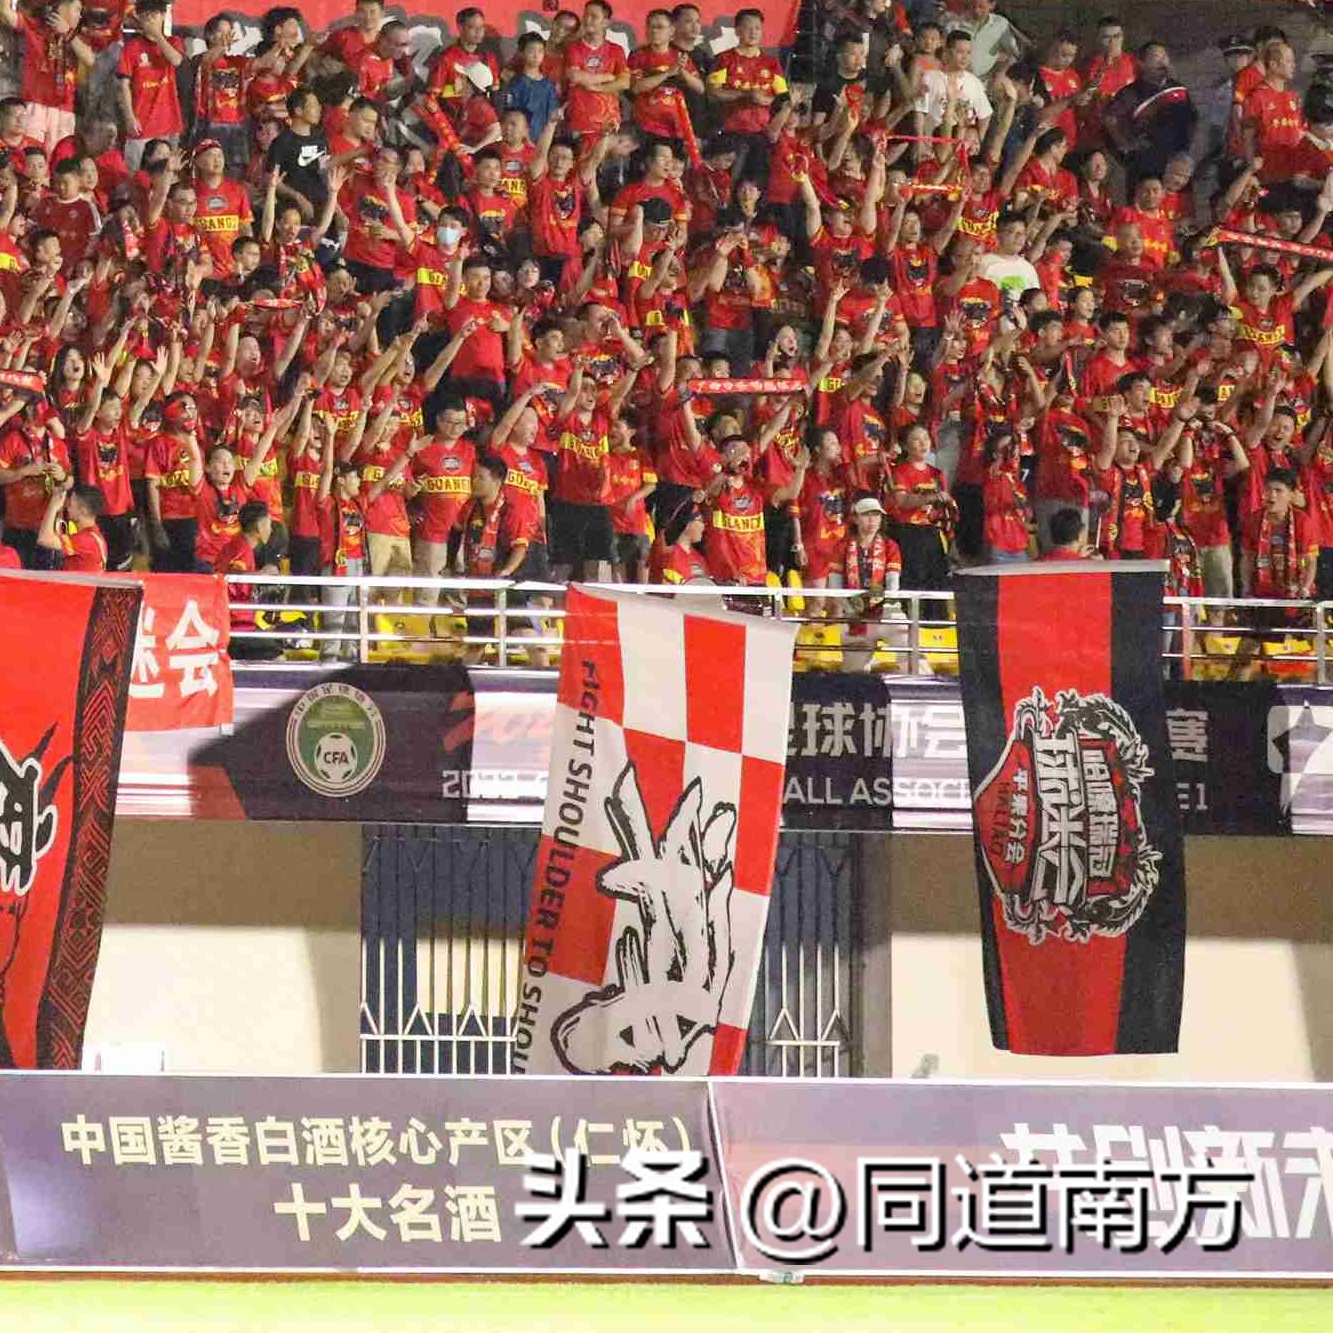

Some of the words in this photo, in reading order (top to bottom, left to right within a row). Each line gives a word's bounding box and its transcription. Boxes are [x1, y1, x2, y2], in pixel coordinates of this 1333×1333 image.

[570, 659, 602, 756] FIGHT
[323, 752, 350, 764] CFA
[536, 757, 595, 930] SHOULDER
[524, 937, 556, 978] TO
[273, 1181, 503, 1243] 十大名酒
